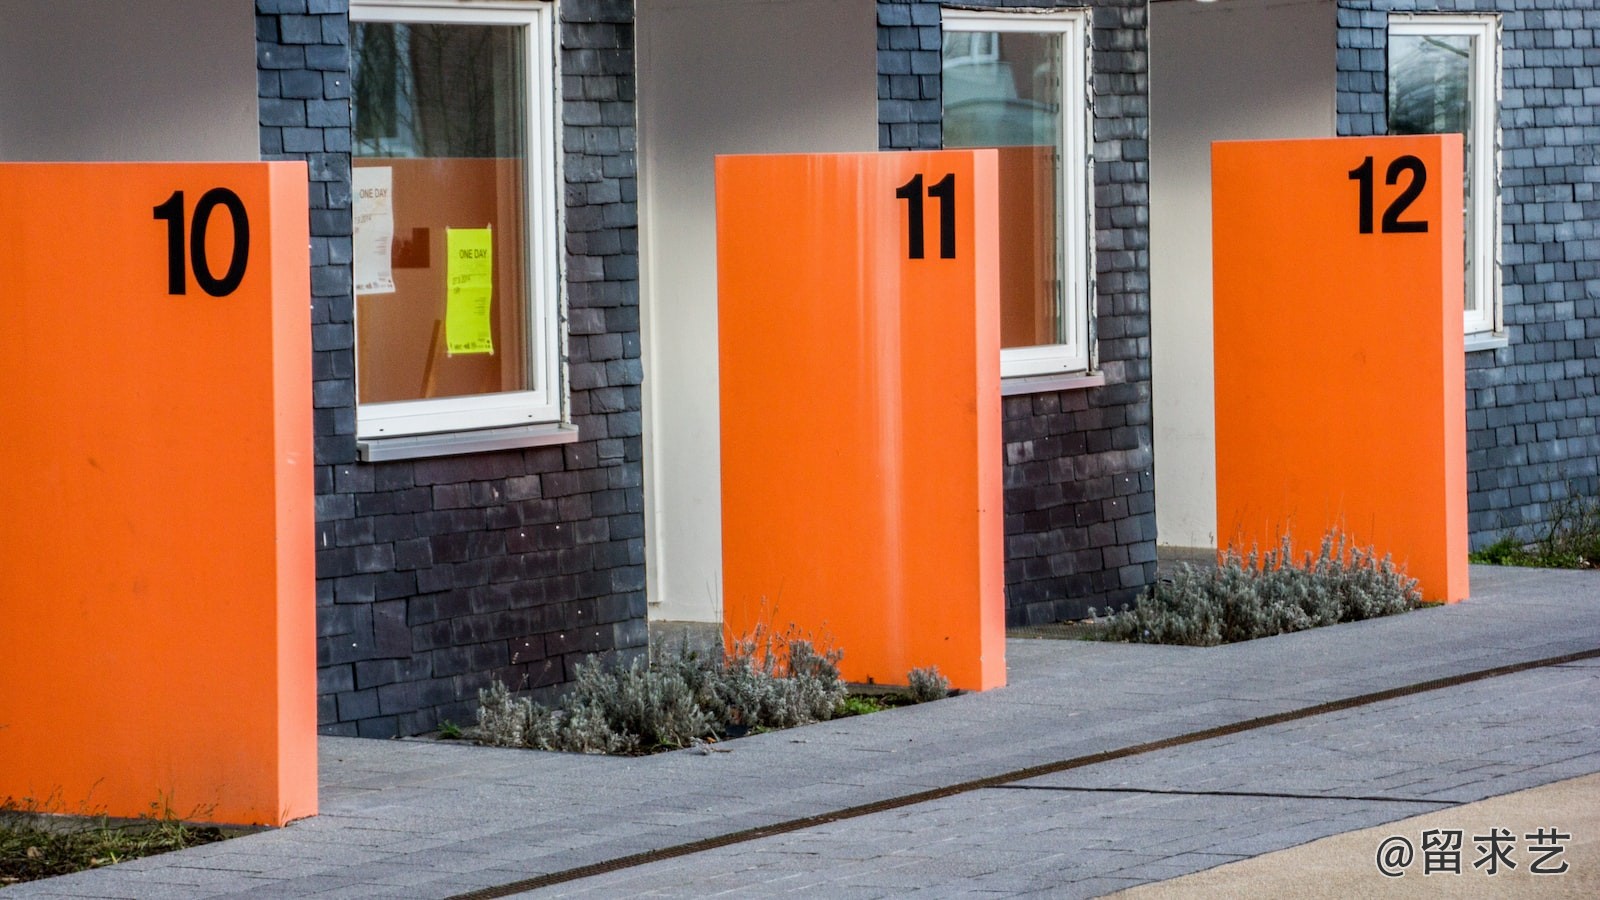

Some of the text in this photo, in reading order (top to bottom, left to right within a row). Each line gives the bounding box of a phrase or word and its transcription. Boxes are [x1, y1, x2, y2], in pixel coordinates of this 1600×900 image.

[359, 187, 387, 199] ONE DAY
[896, 174, 956, 259] 11
[1349, 156, 1428, 233] 12
[154, 188, 250, 297] 10
[459, 248, 487, 259] ONE DAY
